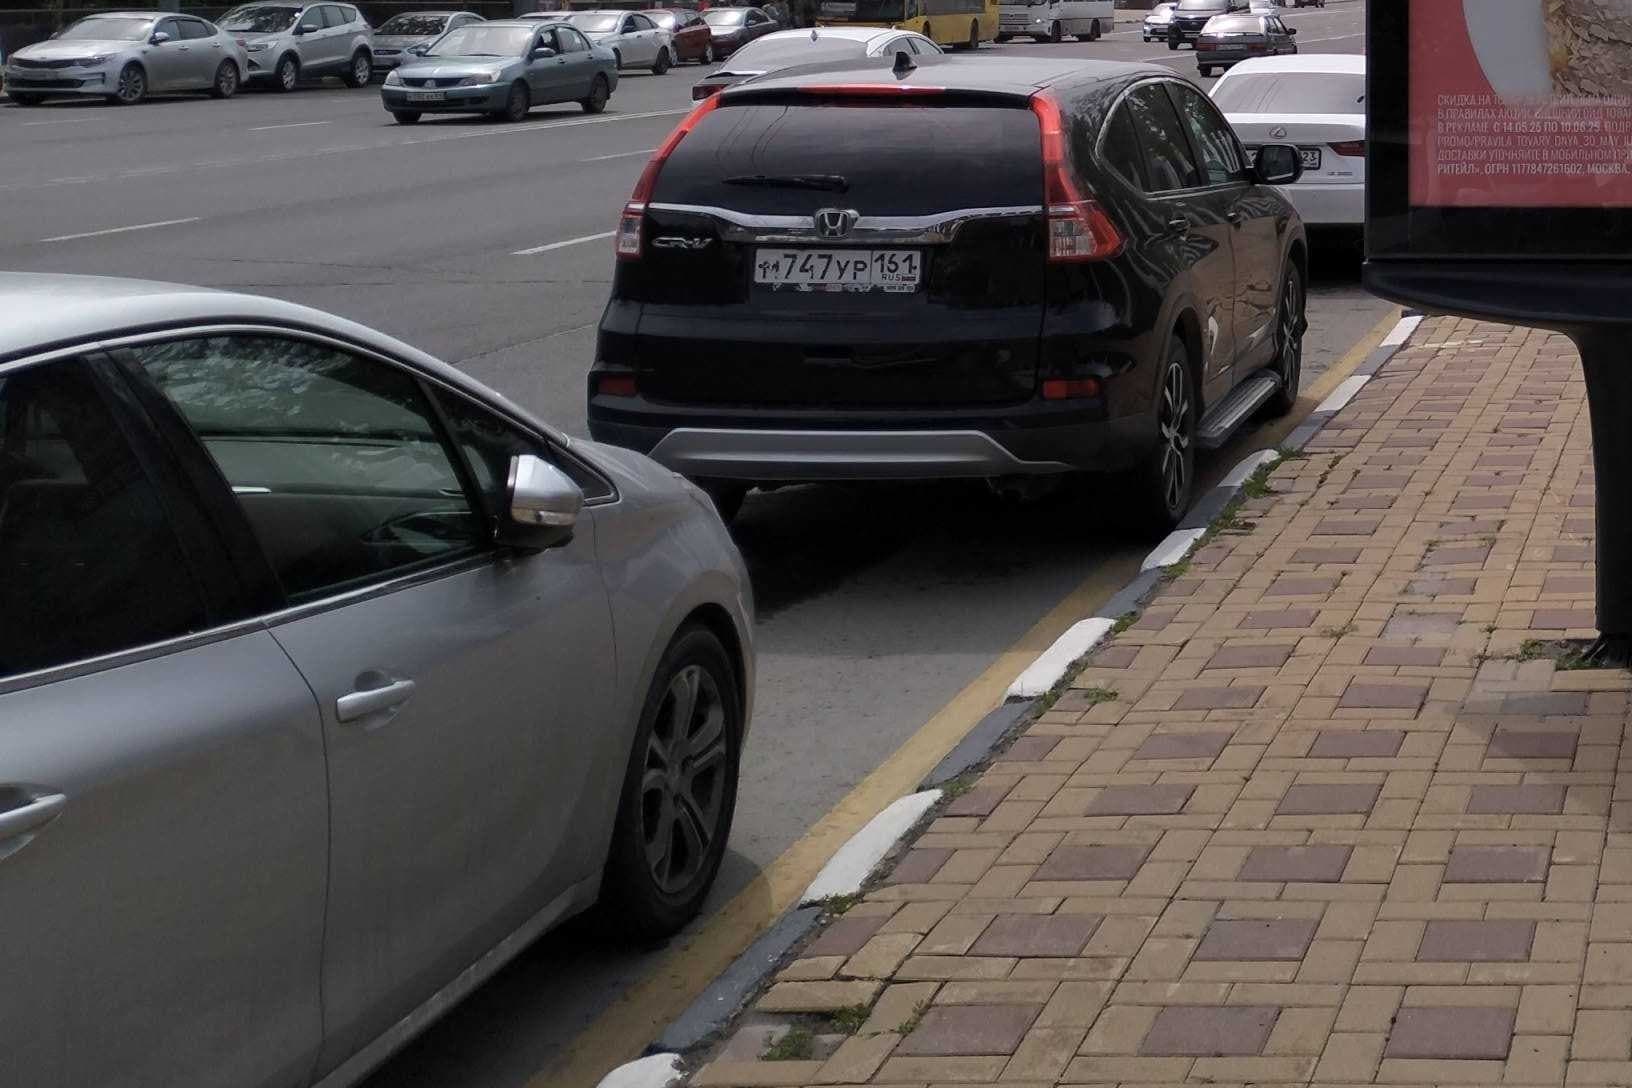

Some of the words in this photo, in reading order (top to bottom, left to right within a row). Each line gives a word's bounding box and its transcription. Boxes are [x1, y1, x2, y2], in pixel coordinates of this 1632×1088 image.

[1437, 95, 1476, 106] СКИДКА
[1486, 163, 1509, 176] ОГРН
[652, 236, 713, 248] CR-V
[882, 273, 901, 281] RUS
